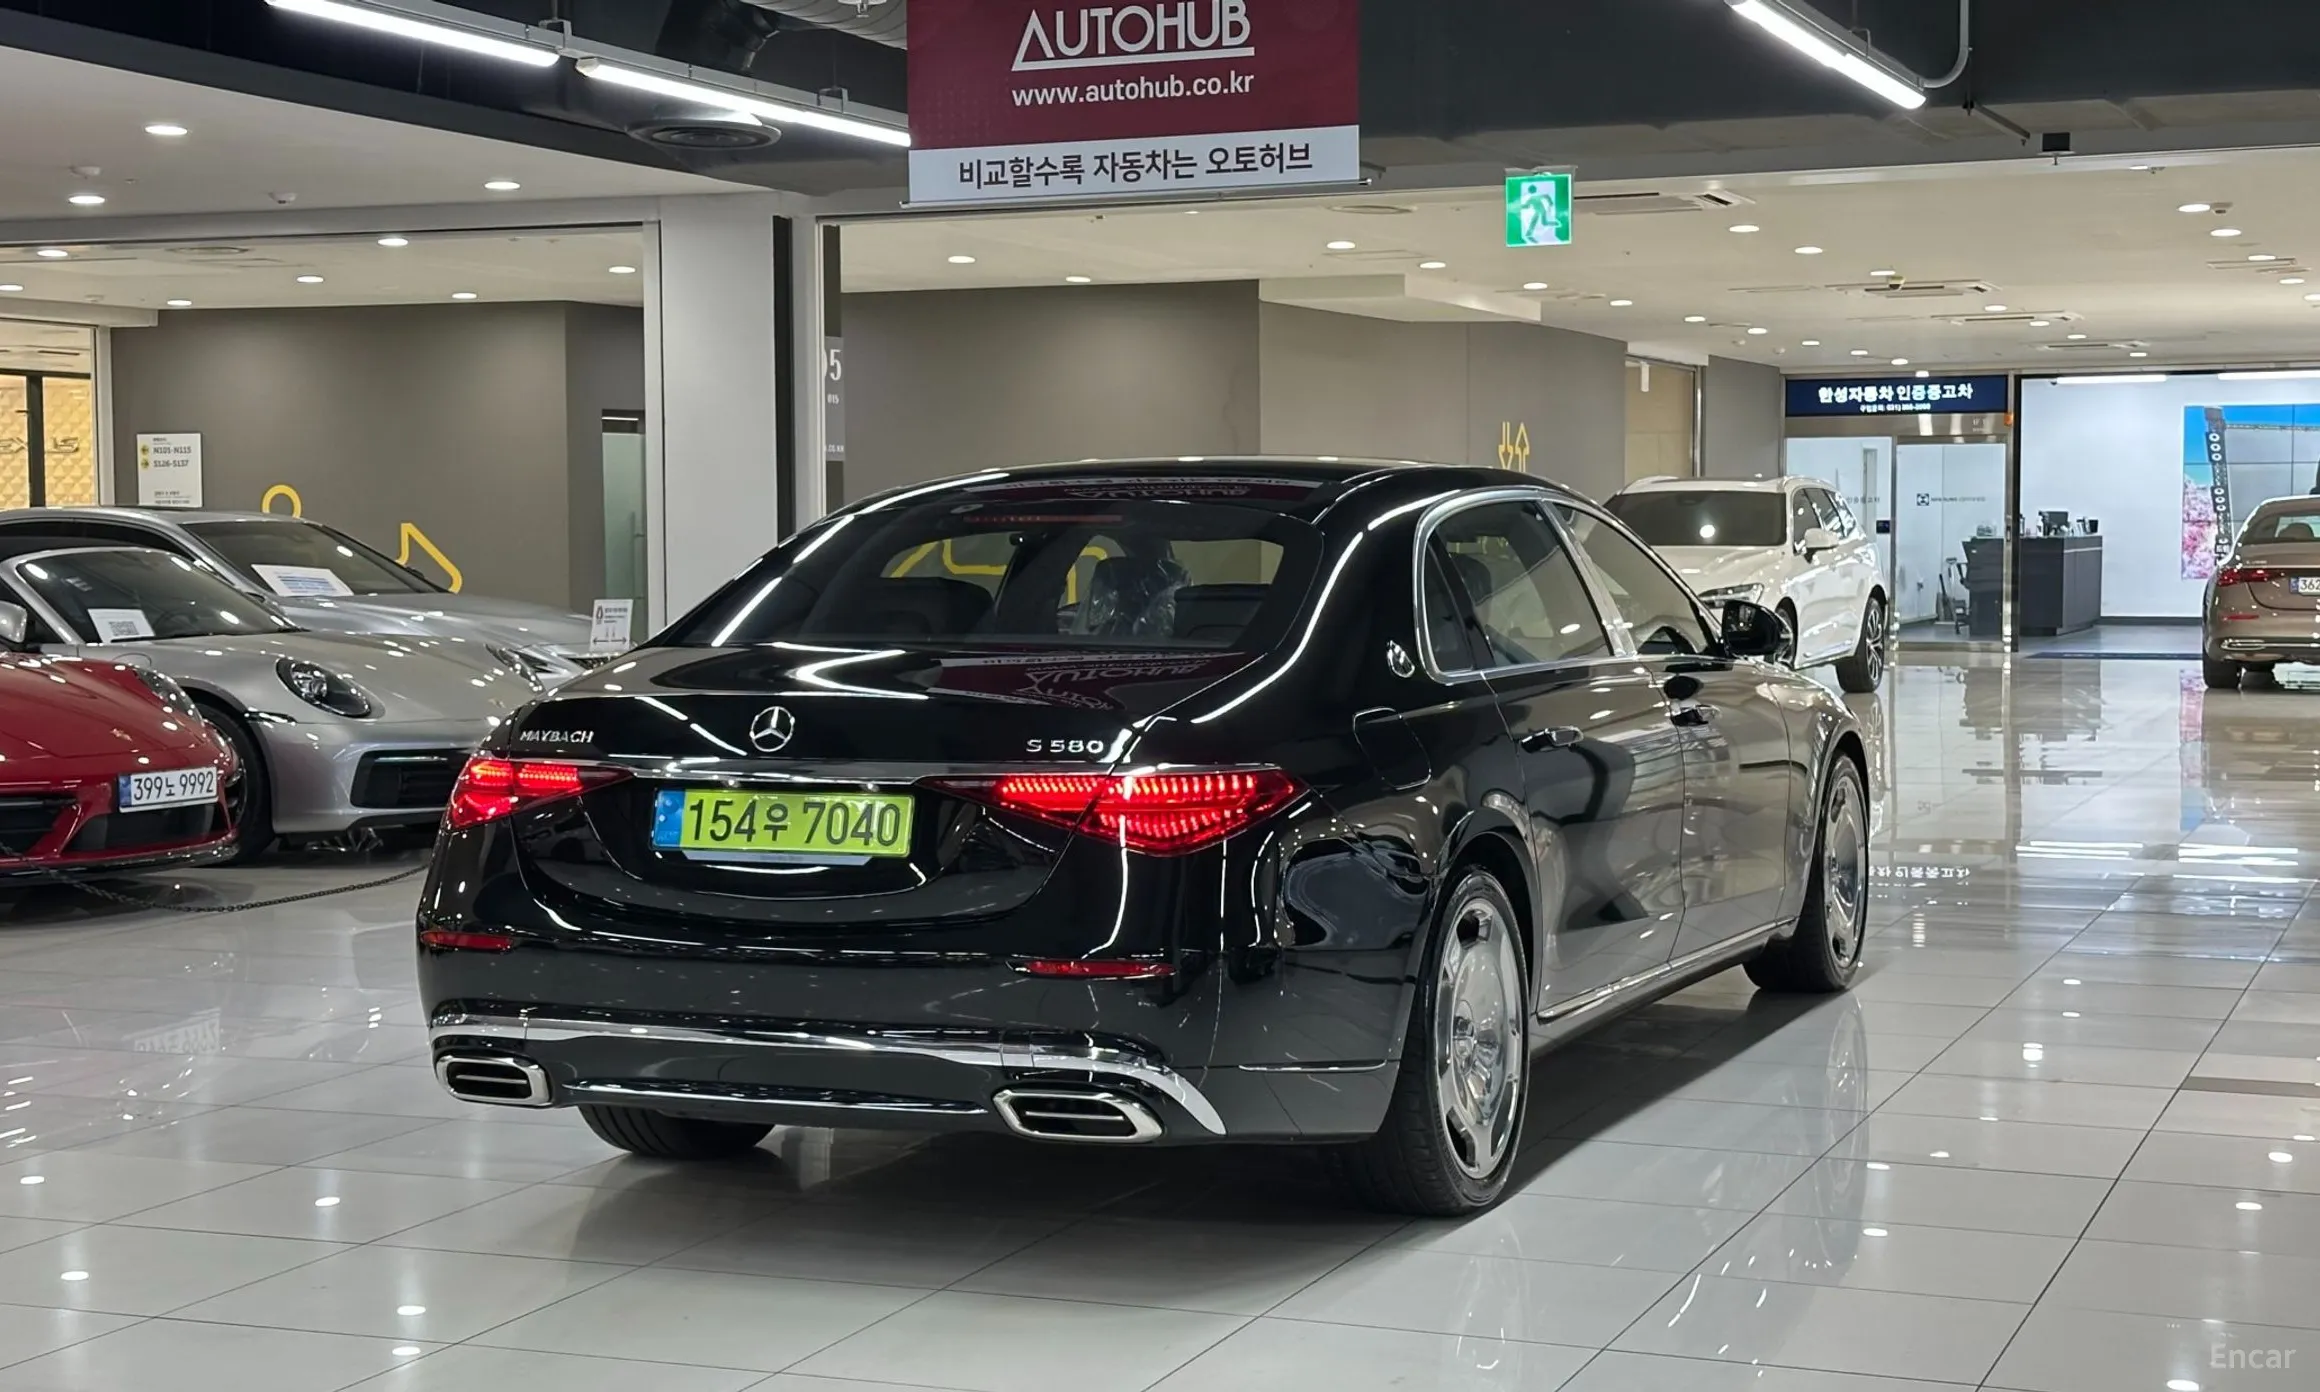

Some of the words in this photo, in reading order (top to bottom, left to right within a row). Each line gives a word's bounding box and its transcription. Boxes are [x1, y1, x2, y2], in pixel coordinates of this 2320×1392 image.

[1011, 0, 1255, 71] AUTOHUB
[1012, 71, 1255, 107] www.autohub.co.kr
[959, 153, 1085, 189] 비교할수록
[1093, 147, 1198, 181] 자동차는
[1204, 142, 1313, 176] 오토허브
[1818, 386, 1894, 404] 한성자동차
[1896, 383, 1974, 401] 인증중고차
[519, 729, 595, 743] MAYBACH
[1026, 739, 1042, 753] S
[1049, 739, 1104, 754] 580
[133, 776, 176, 801] 399노
[179, 771, 214, 796] 9992
[688, 798, 789, 843] 154우
[802, 801, 900, 847] 7040
